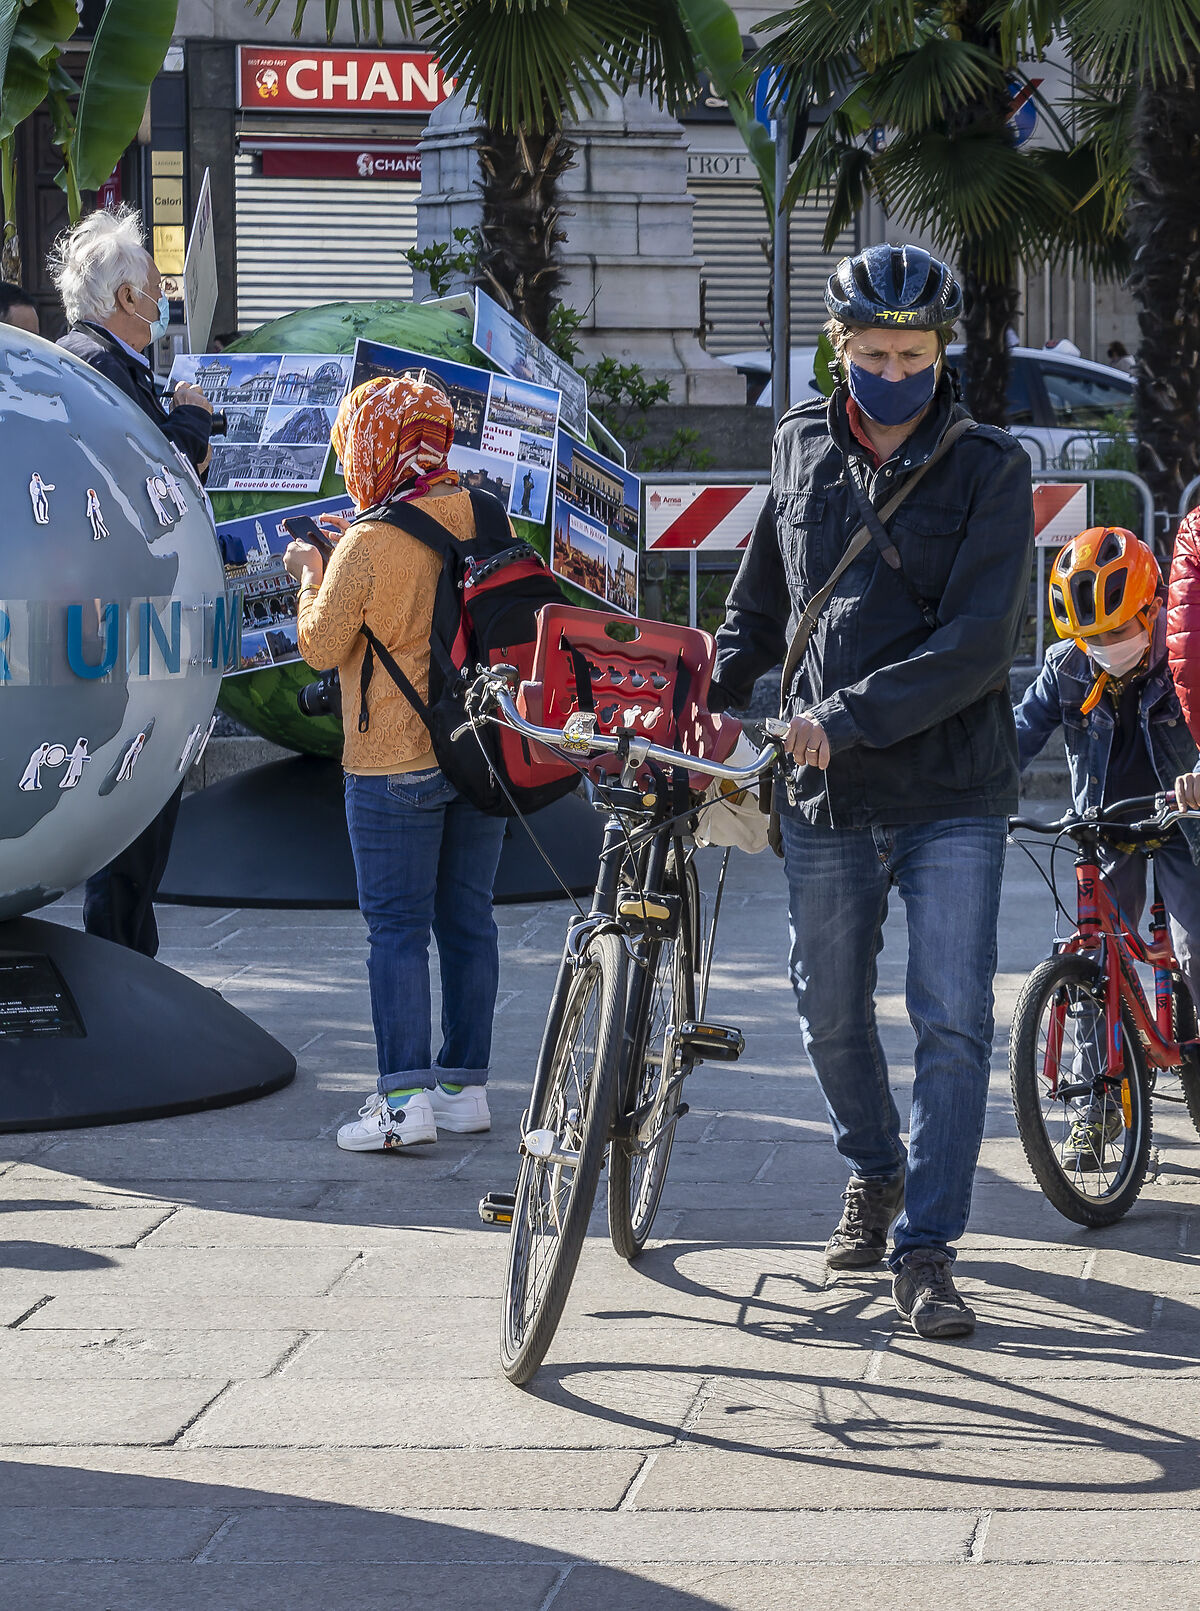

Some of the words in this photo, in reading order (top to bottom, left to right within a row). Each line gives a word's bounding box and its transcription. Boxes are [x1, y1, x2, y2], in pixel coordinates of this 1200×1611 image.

[155, 197, 182, 206] Calori
[484, 425, 512, 437] saluti
[483, 432, 494, 440] da
[482, 442, 515, 456] Torino
[234, 481, 268, 489] Recuerdo
[281, 481, 308, 489] Genova
